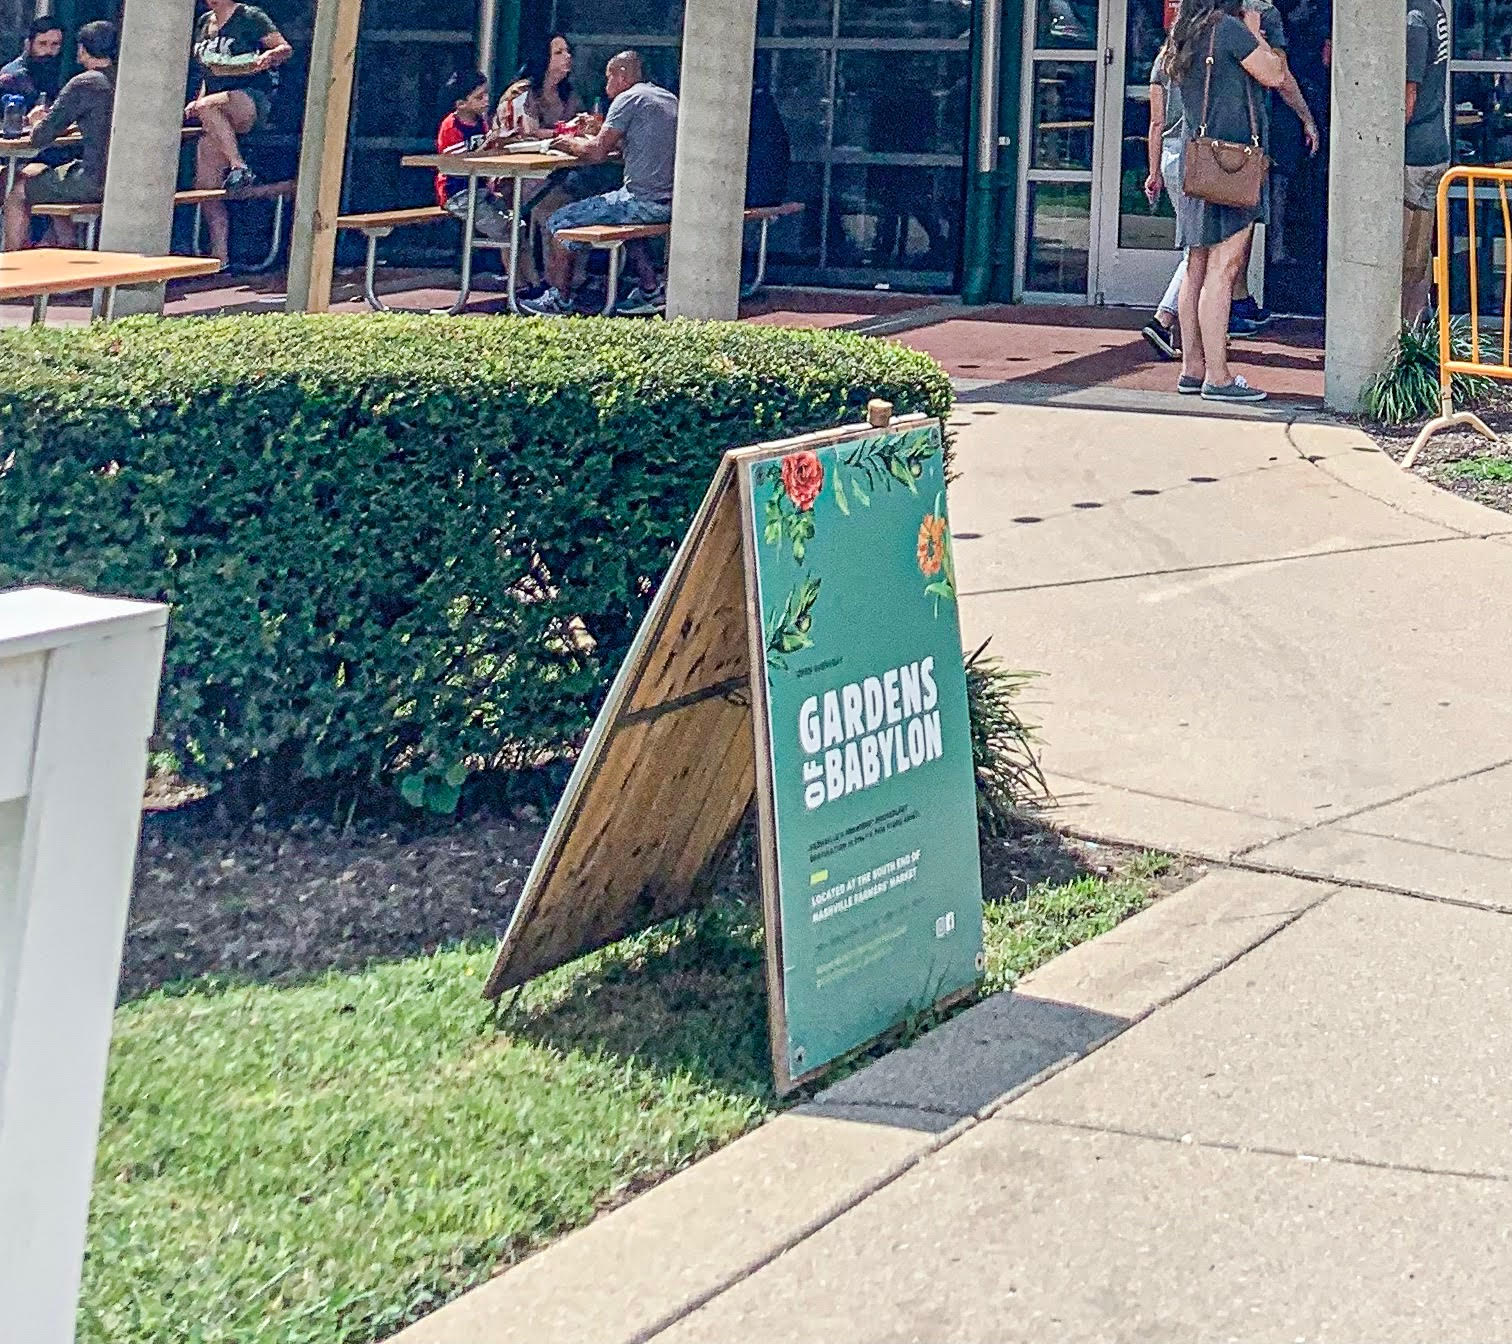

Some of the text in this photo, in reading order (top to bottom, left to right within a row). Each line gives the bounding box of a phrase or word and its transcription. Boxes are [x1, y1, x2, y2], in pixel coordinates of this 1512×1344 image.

[799, 655, 938, 754] GARDENS
[803, 709, 944, 810] OF BABYLON
